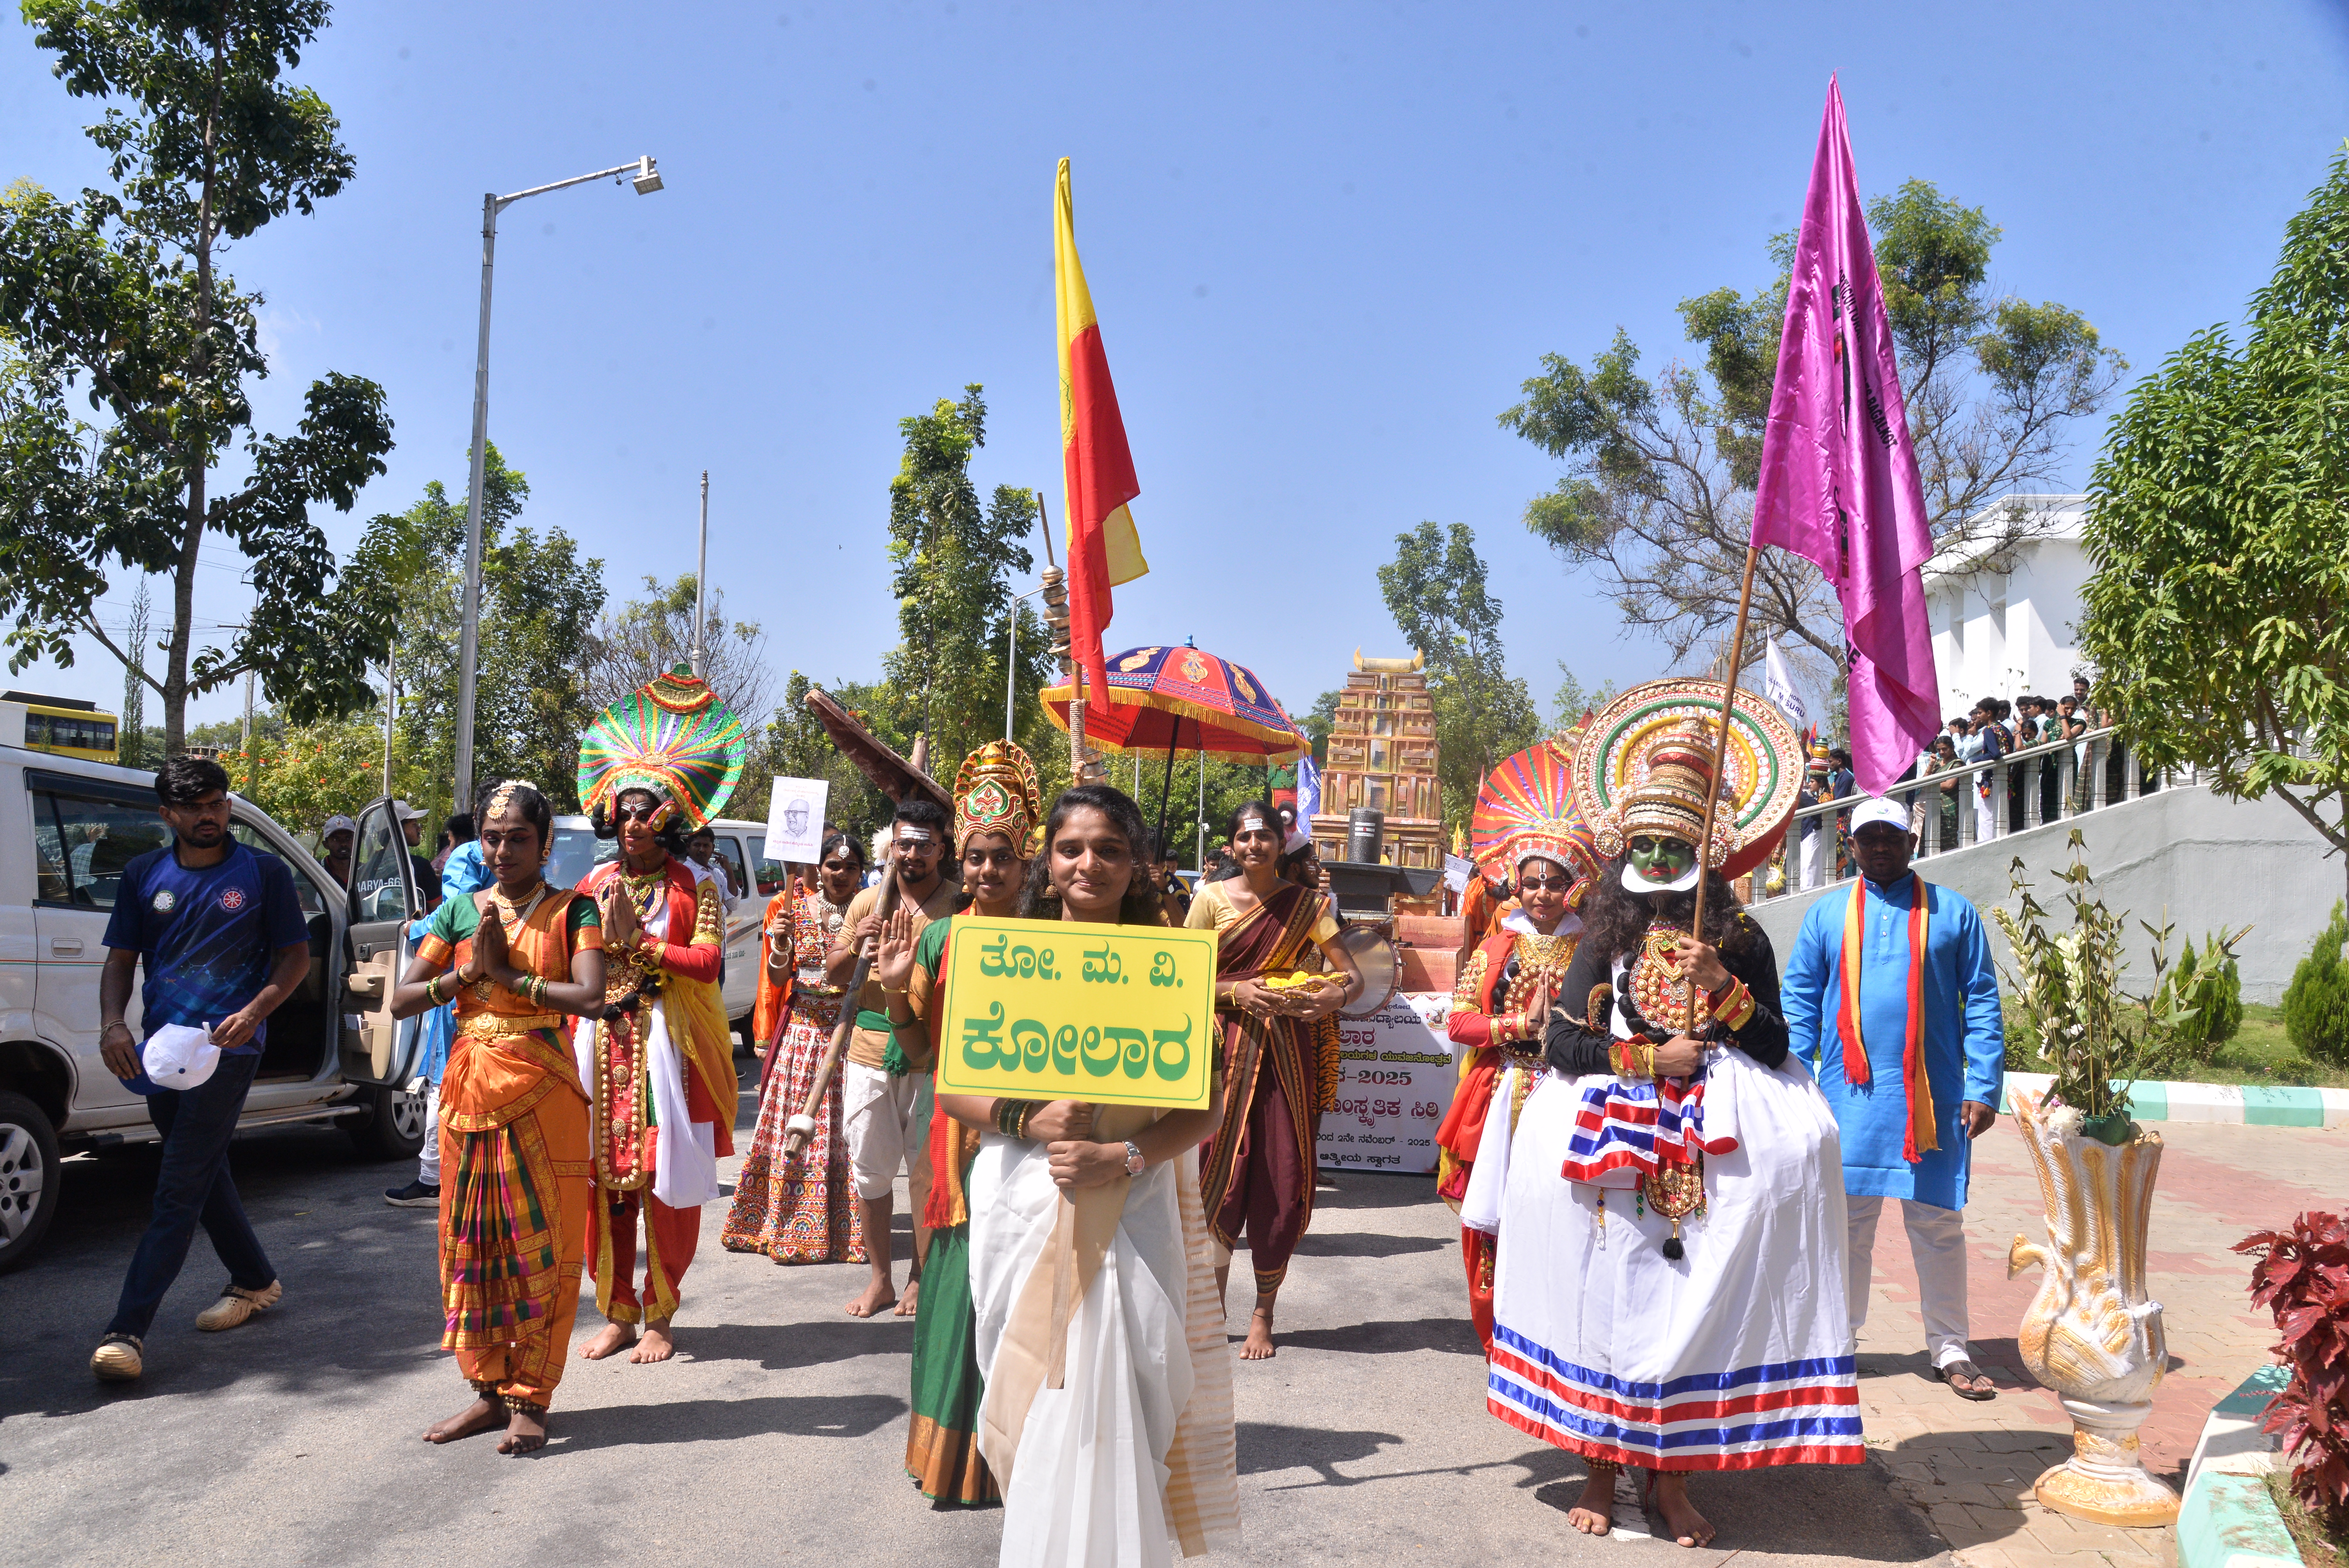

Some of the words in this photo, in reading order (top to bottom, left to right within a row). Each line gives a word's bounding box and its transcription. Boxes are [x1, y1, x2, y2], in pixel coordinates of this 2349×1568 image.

[980, 934, 1061, 981] ತೋ.
[1082, 940, 1128, 984] ಮ.
[1150, 951, 1183, 988] ವಿ.
[962, 1001, 1192, 1082] ಕೋಲಾರ
[1340, 1026, 1376, 1047] ಲಾರ
[1380, 1050, 1452, 1067] ಯುವಜನೋತ್ಸವ
[1411, 1101, 1440, 1119] ಸಿರಿ
[1338, 1133, 1355, 1143] 2ನೇ
[1358, 1134, 1395, 1144] ನವೆಂಬರ್
[1320, 1152, 1362, 1166] ಆತ್ಮೀಯ
[1367, 1155, 1401, 1167] ಸ್ವಾಗತ
